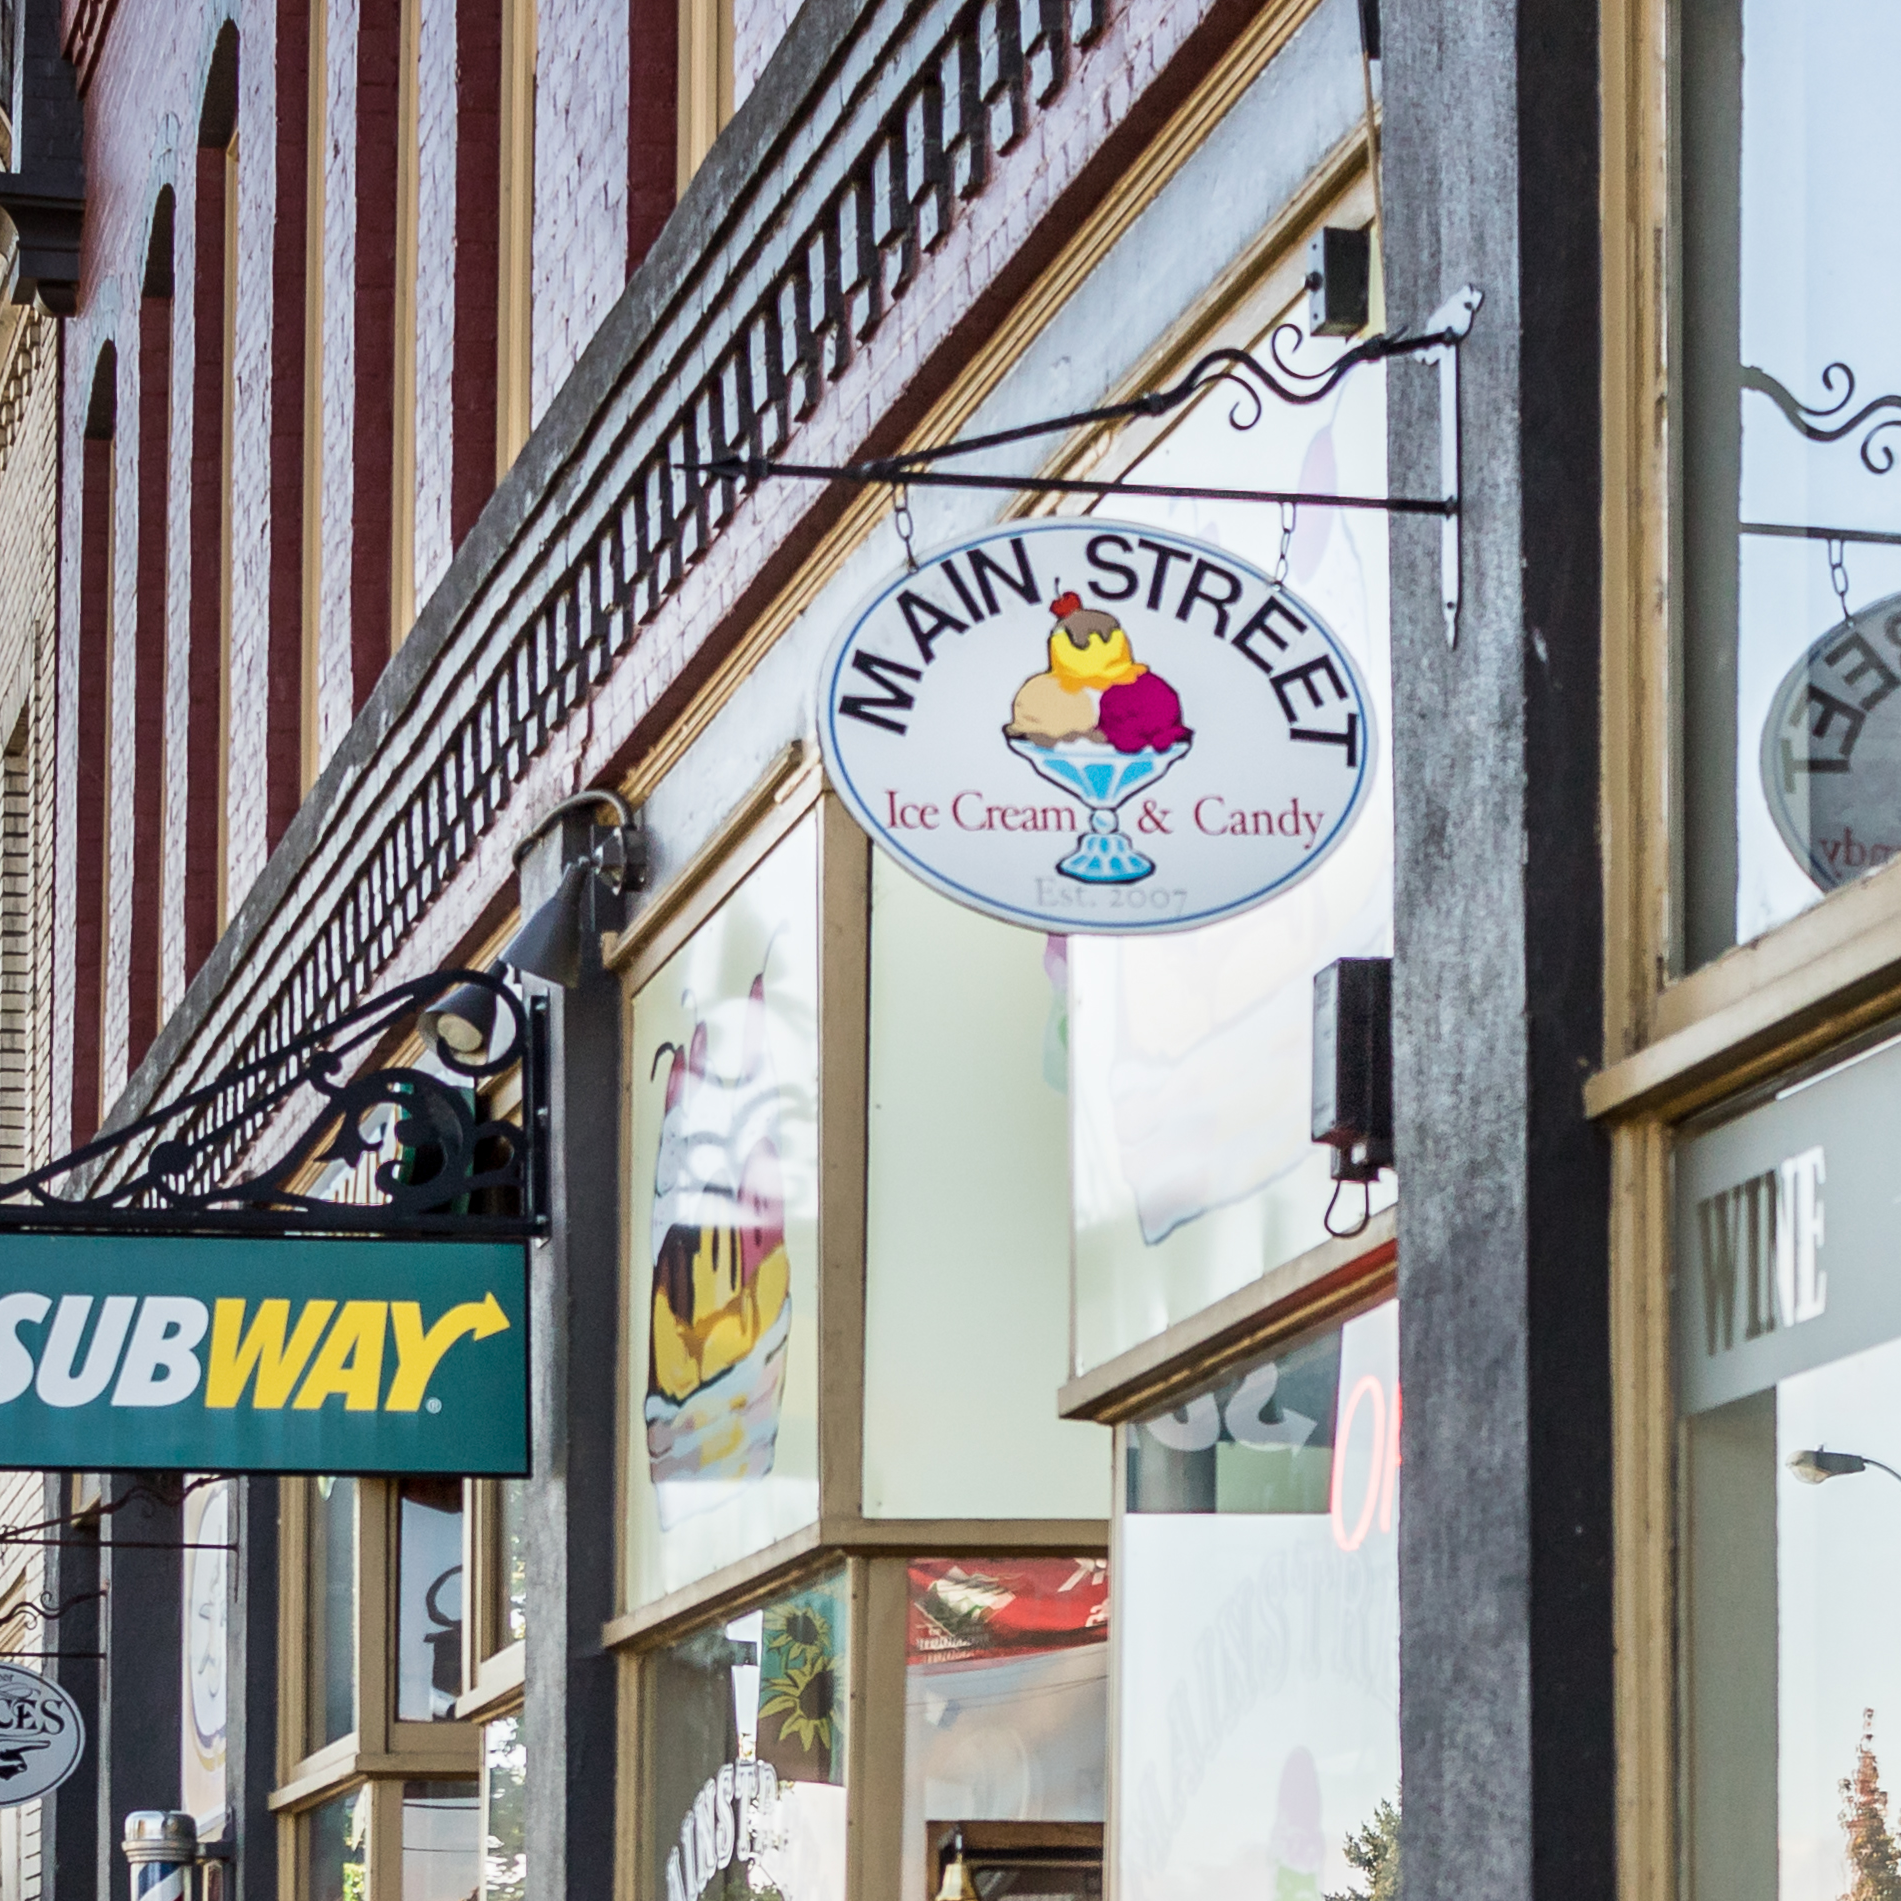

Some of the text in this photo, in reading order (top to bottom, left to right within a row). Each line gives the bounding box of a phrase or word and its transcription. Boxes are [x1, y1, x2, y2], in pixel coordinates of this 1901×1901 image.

[838, 534, 1358, 768] MAIN STREET
[883, 789, 1325, 850] Ice Cream & Candy
[1035, 878, 1188, 912] Est. 2007
[1699, 1144, 1828, 1360] WINE
